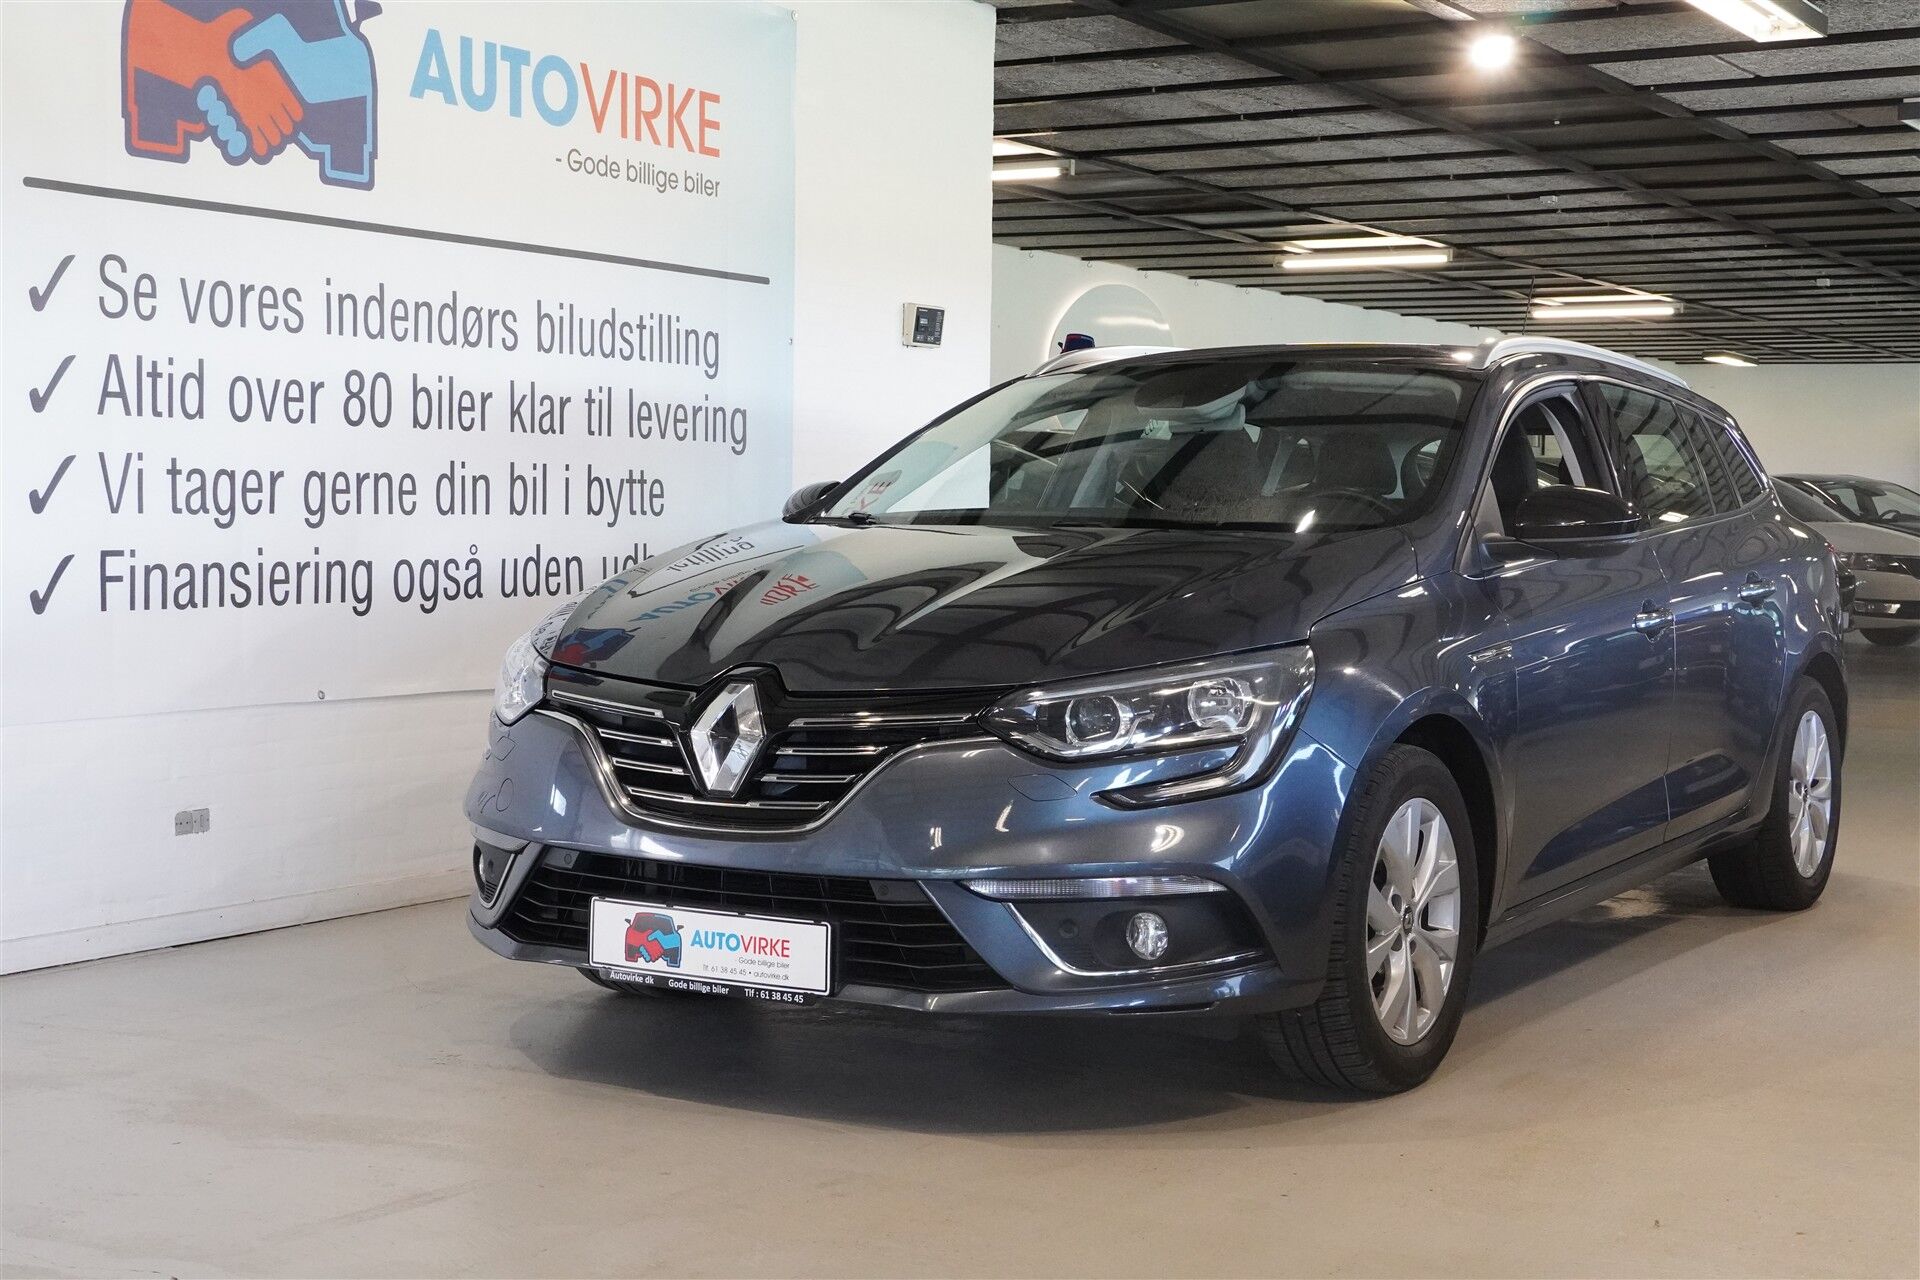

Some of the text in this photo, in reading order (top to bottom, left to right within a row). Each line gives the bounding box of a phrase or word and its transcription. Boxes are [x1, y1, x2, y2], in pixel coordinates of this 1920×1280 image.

[409, 28, 721, 158] AUTOVIRKE
[567, 148, 621, 179] Gode
[626, 158, 679, 194] billige
[684, 170, 721, 198] biler
[98, 253, 720, 380] Se vores indendørs biludstilling
[97, 353, 748, 456] Altid over 80 biler klar til levering
[98, 451, 665, 530] Vi tager gerne din bil i bytte
[99, 549, 373, 617] Finansiering
[393, 543, 484, 615] også
[500, 543, 585, 599] uden
[690, 929, 790, 958] AUTOVIRKE
[739, 957, 757, 966] Gode
[776, 961, 790, 969] biler
[668, 979, 688, 990] Gode
[689, 982, 711, 994] billige
[712, 985, 730, 995] biler
[760, 990, 770, 999] 61
[771, 991, 781, 1001] 38
[782, 993, 792, 1002] 45
[793, 995, 804, 1003] 45
